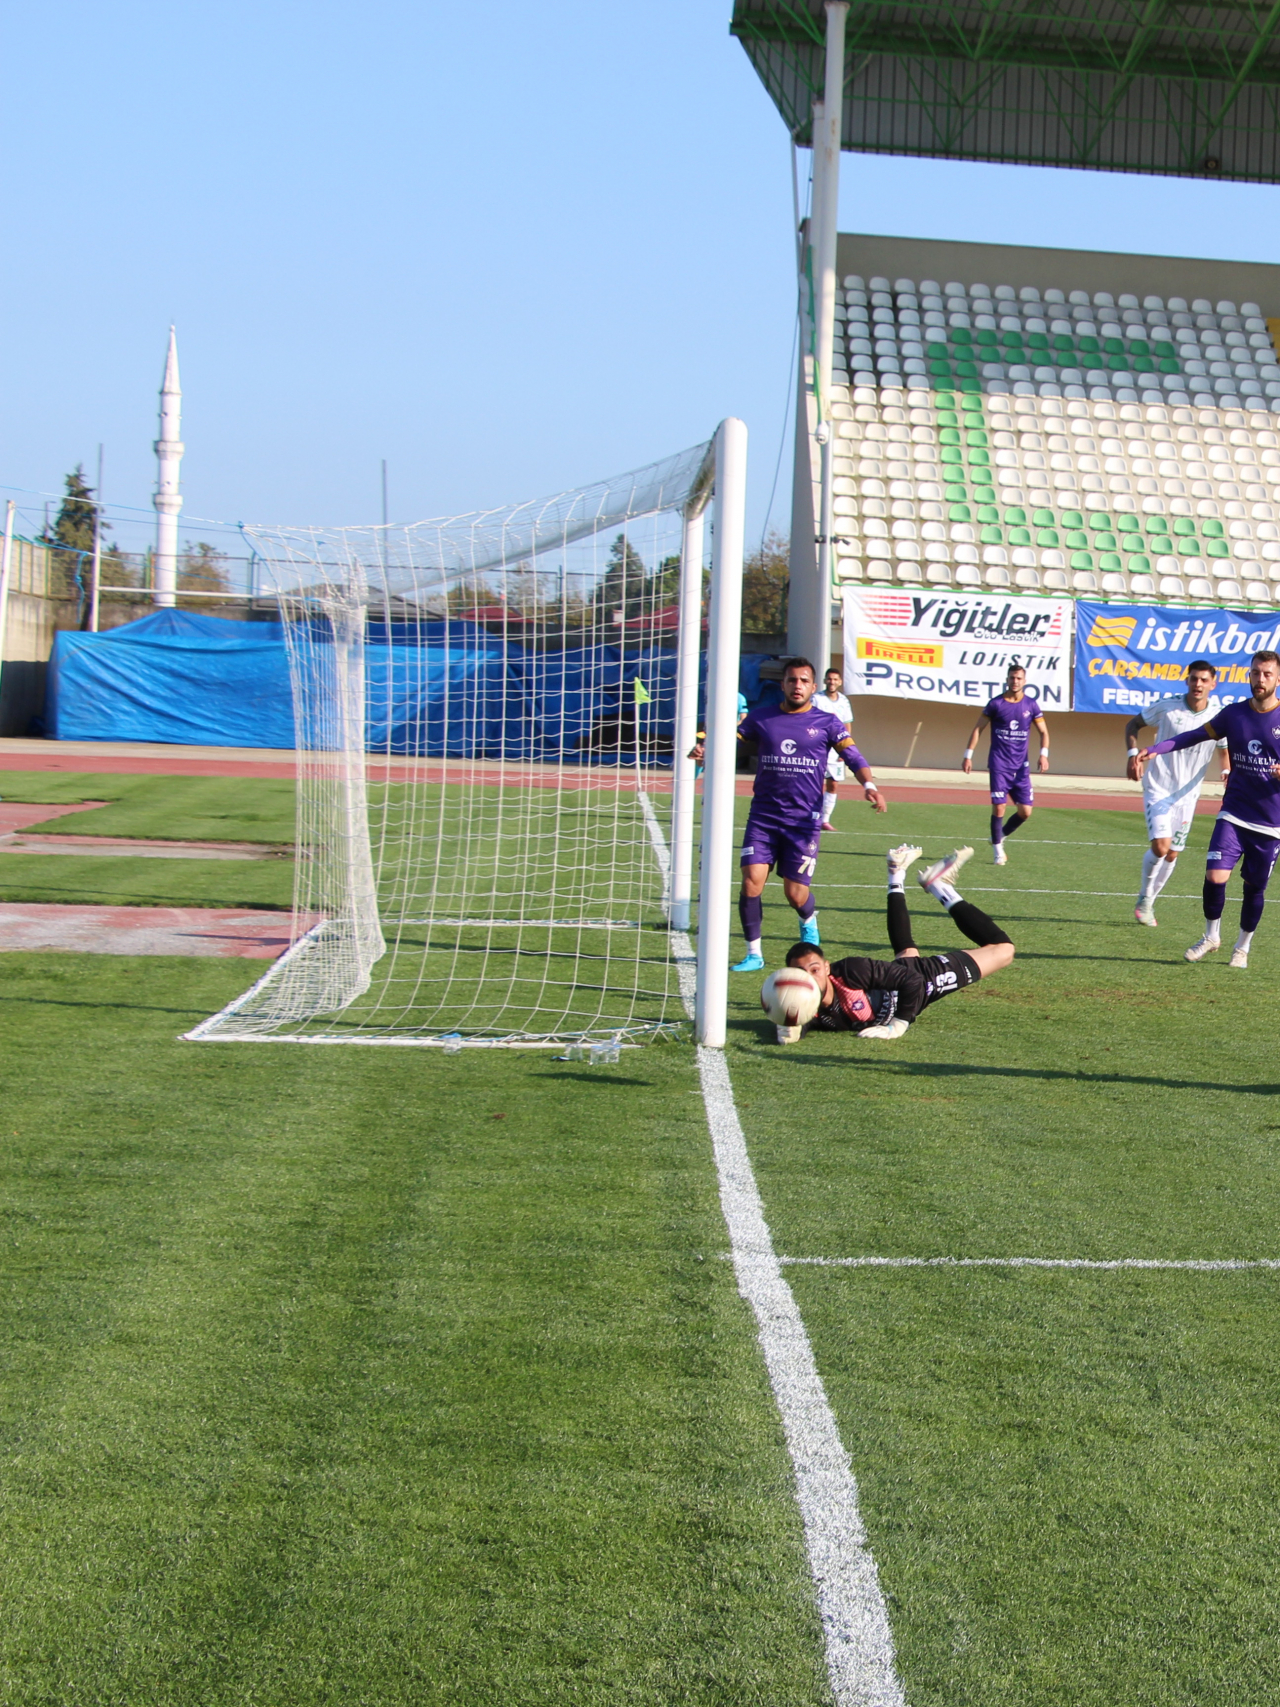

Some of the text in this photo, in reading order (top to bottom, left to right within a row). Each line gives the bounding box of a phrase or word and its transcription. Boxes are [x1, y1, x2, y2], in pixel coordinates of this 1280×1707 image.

[910, 597, 1051, 638] Yiğitler
[865, 641, 935, 664] PIRELLI
[935, 970, 958, 994] 13
